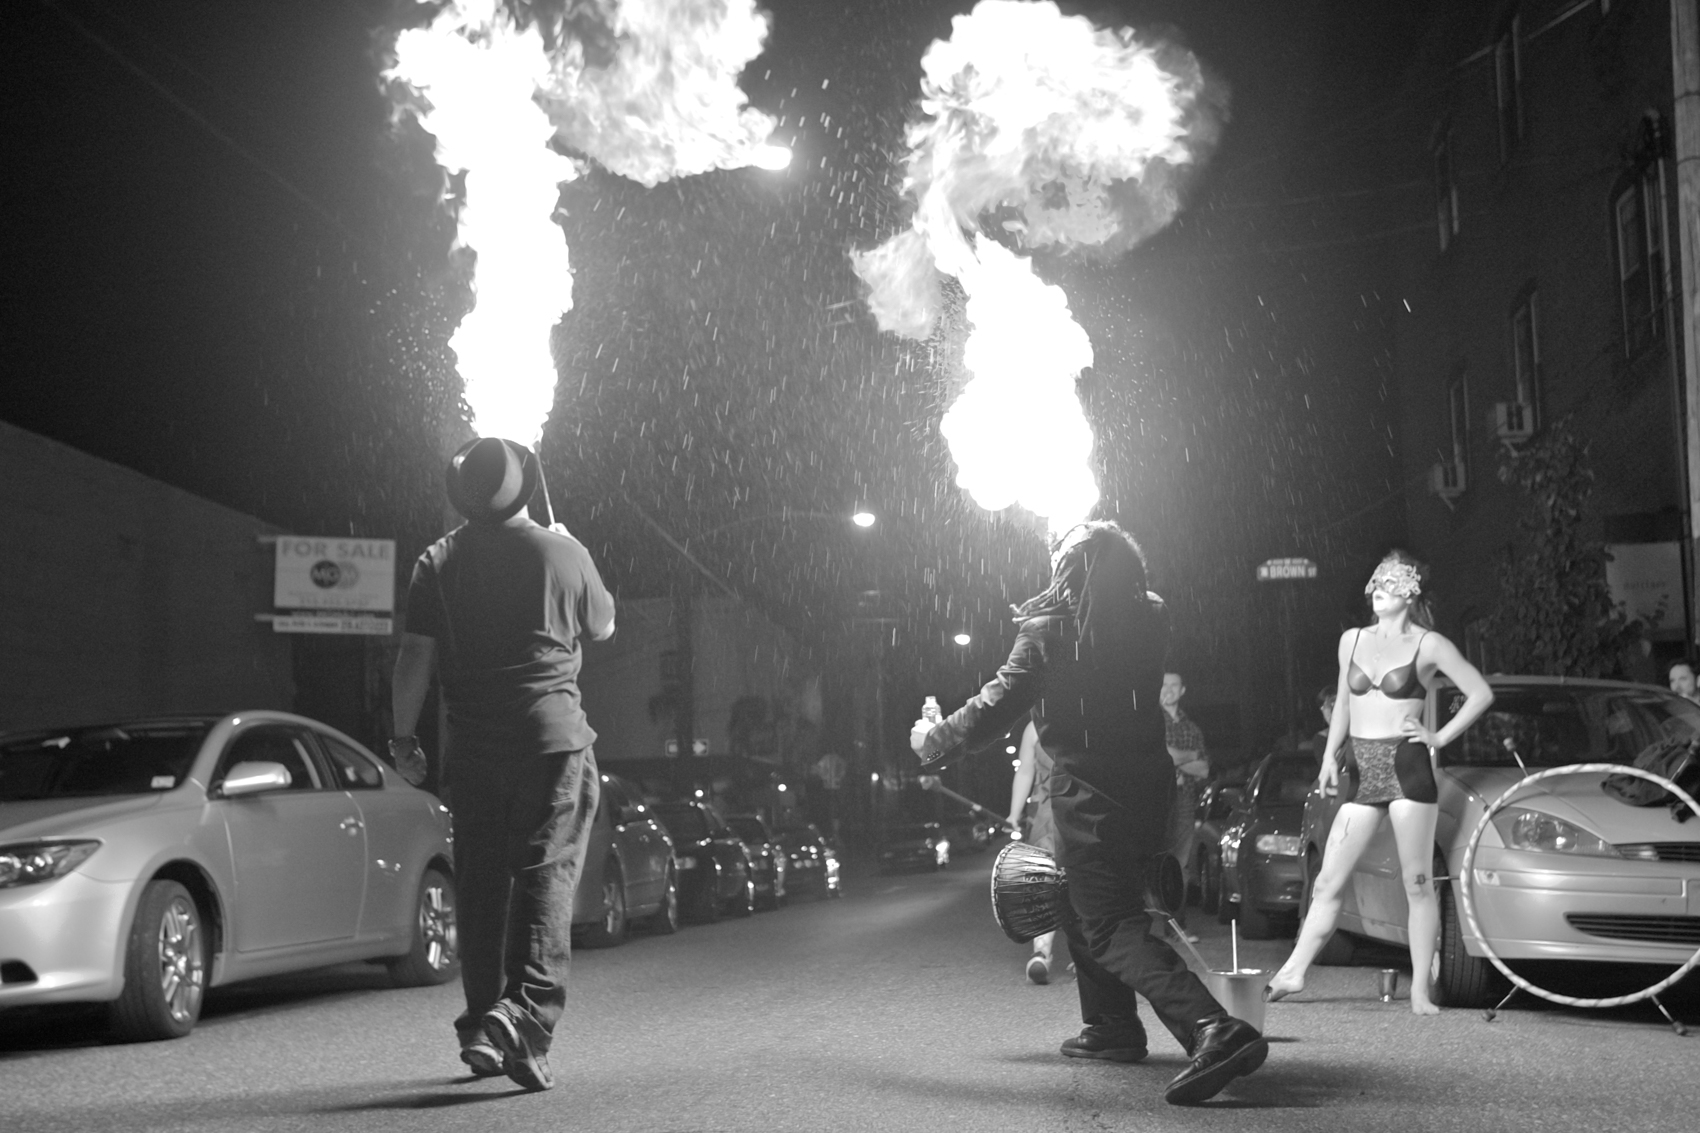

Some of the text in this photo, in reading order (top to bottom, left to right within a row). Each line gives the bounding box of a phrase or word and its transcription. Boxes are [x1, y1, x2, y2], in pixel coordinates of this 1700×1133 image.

[282, 541, 390, 560] FOR SALE
[1270, 565, 1306, 579] BROWN
